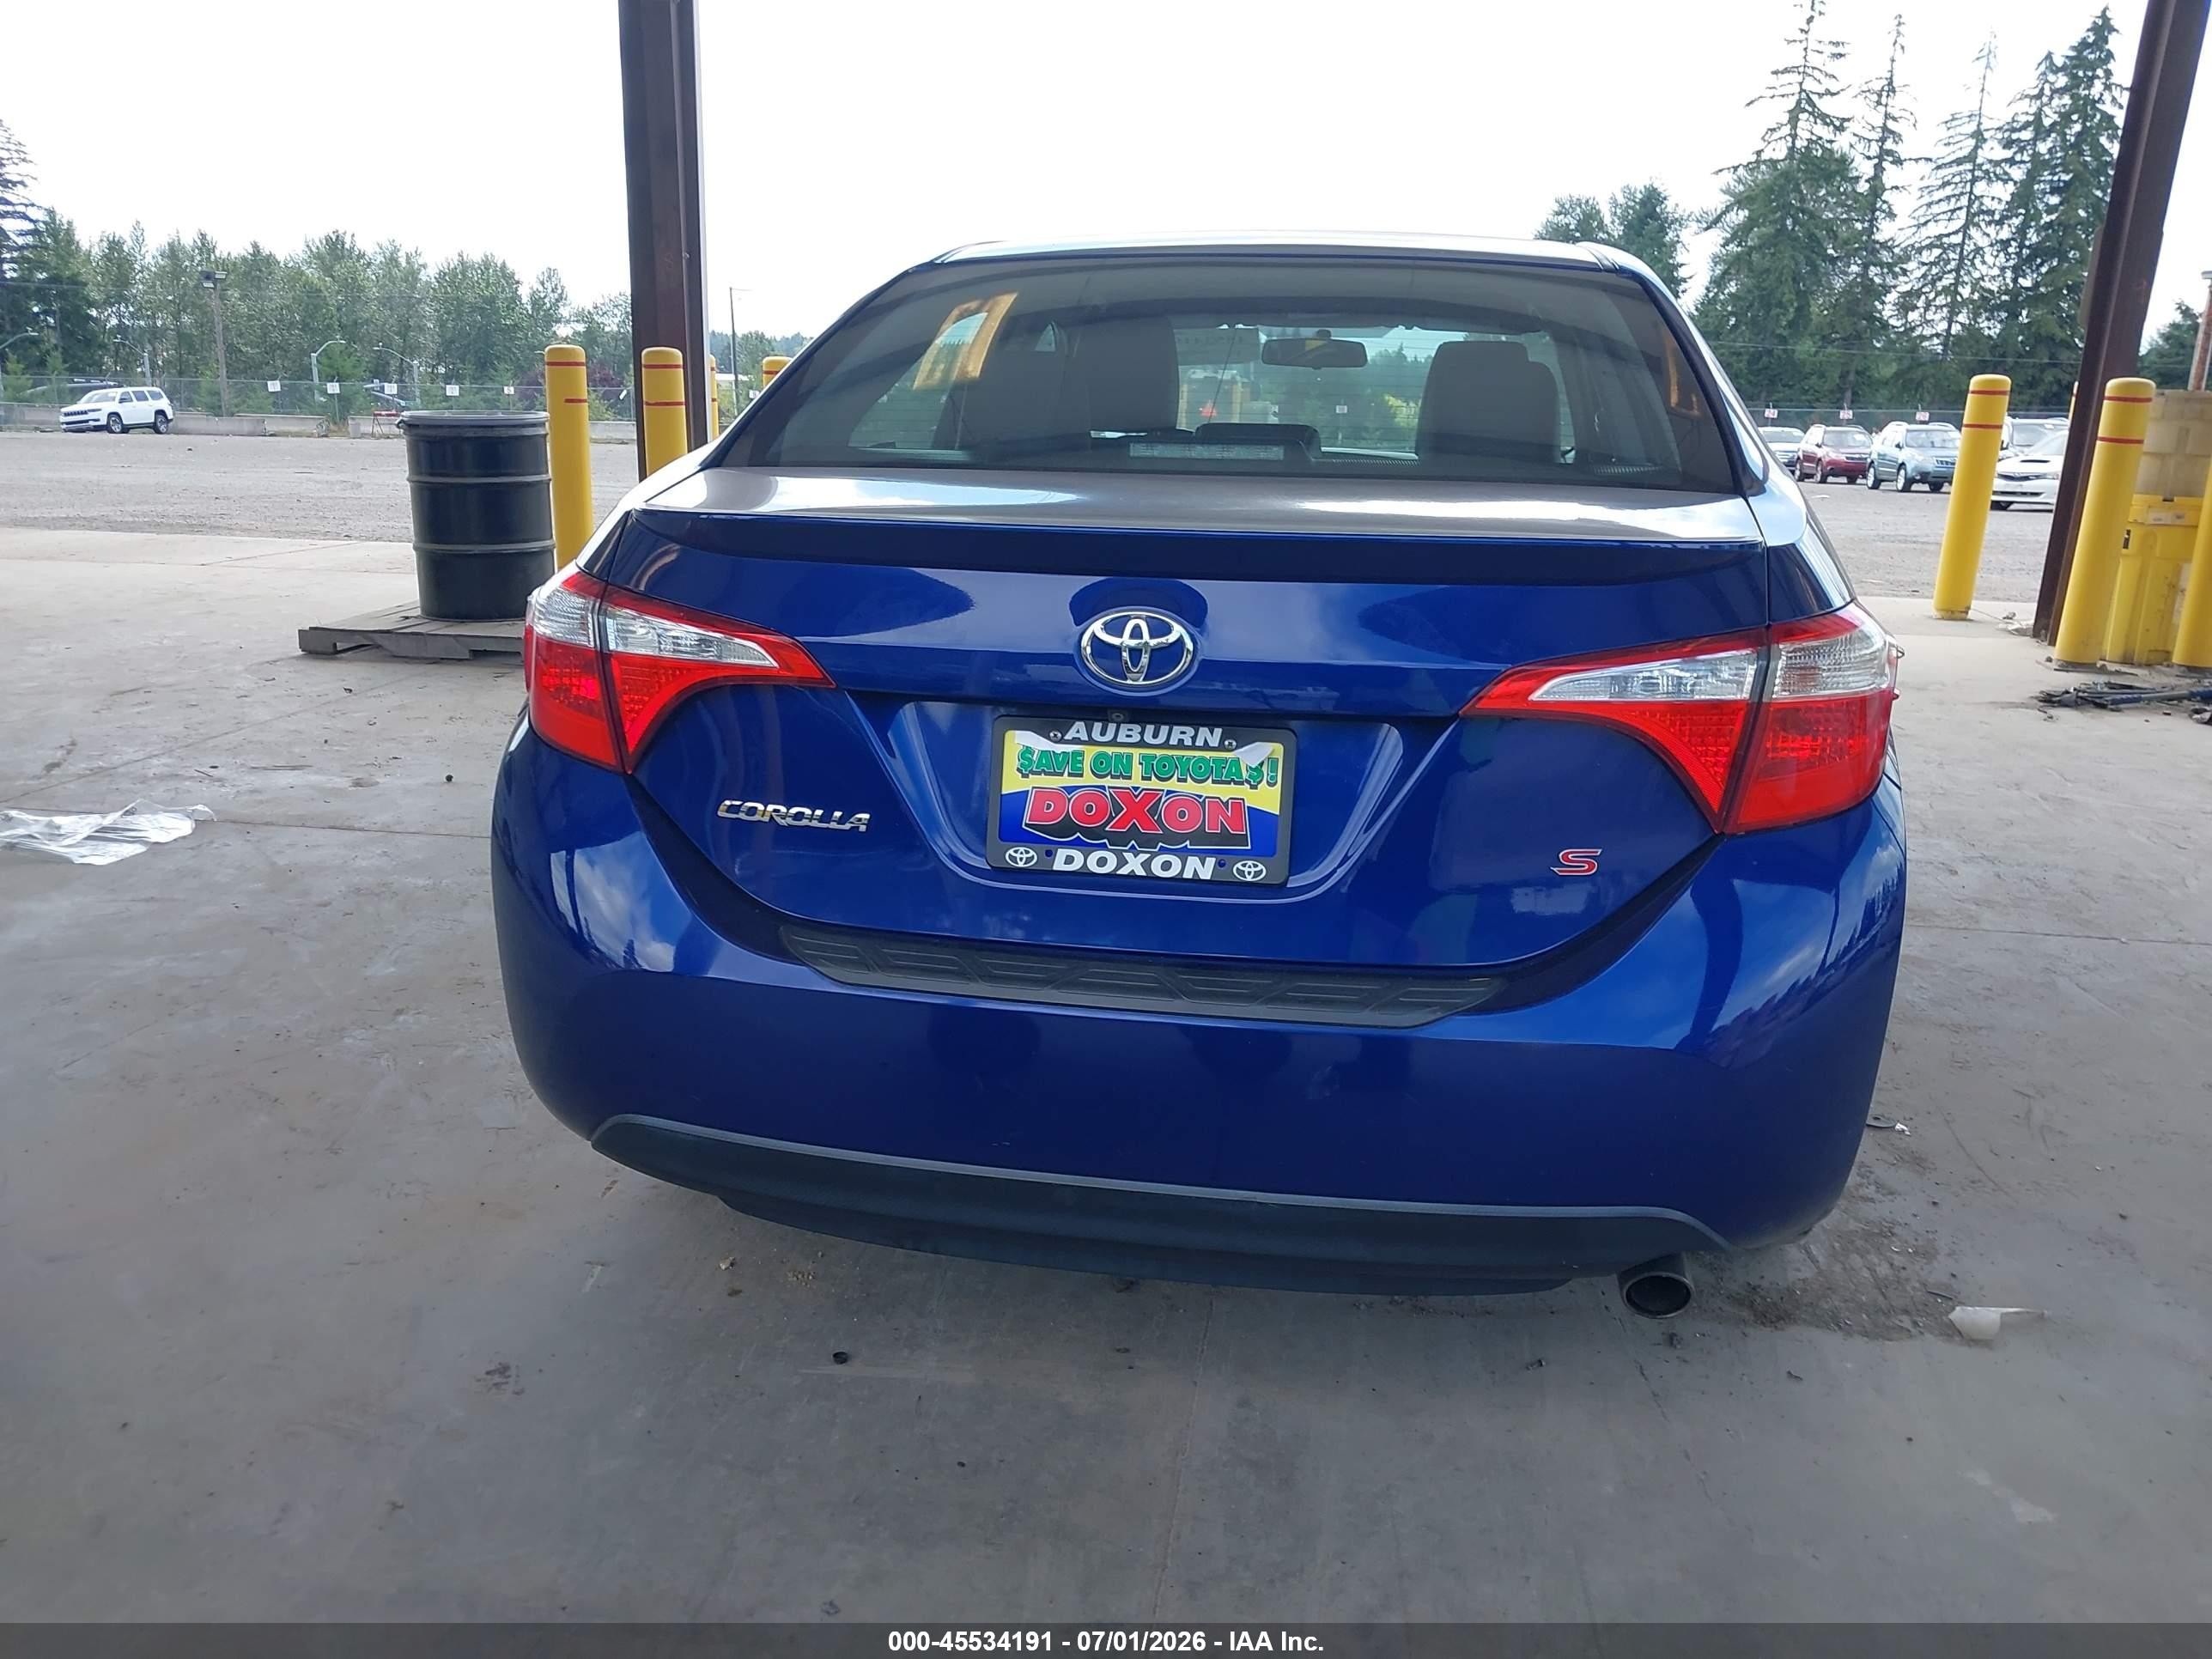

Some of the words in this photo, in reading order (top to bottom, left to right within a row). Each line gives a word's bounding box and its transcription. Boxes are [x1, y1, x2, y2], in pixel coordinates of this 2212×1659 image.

[1063, 720, 1224, 748] AUBURN
[1016, 744, 1085, 778] $AVE
[1090, 750, 1133, 779] ON
[717, 799, 871, 832] COROLLA
[1024, 785, 1248, 836] DOXON
[1052, 848, 1217, 880] DOXON
[1550, 848, 1603, 876] S
